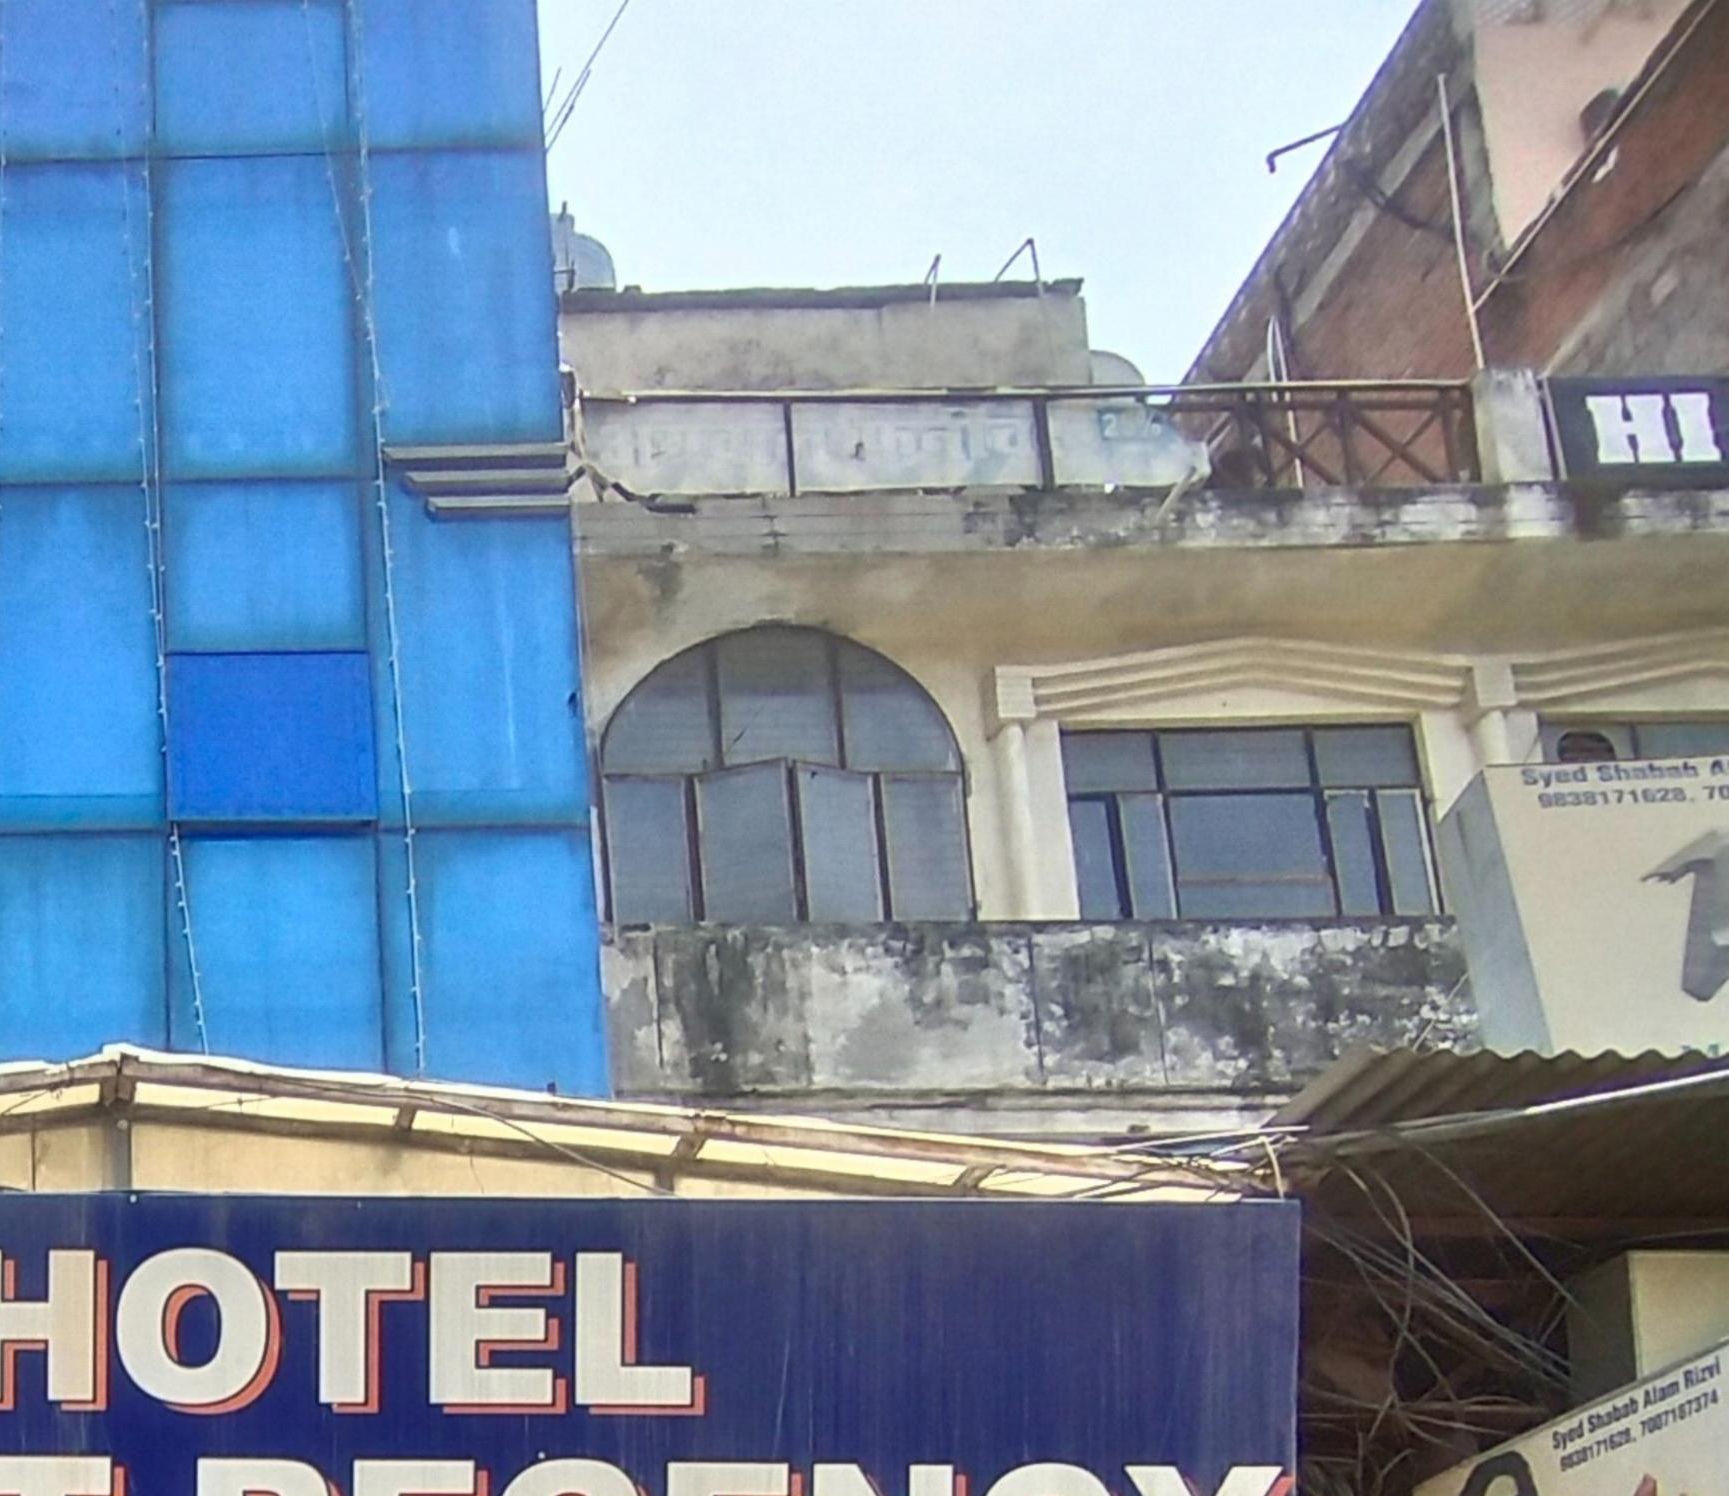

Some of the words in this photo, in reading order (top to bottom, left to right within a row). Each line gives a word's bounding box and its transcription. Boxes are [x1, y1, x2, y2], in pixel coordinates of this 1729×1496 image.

[1521, 766, 1588, 788] Syed
[1710, 759, 1729, 776] A
[1552, 1419, 1585, 1450] Syed
[1643, 1382, 1681, 1410] Alam
[1682, 1356, 1721, 1390] Rizvi
